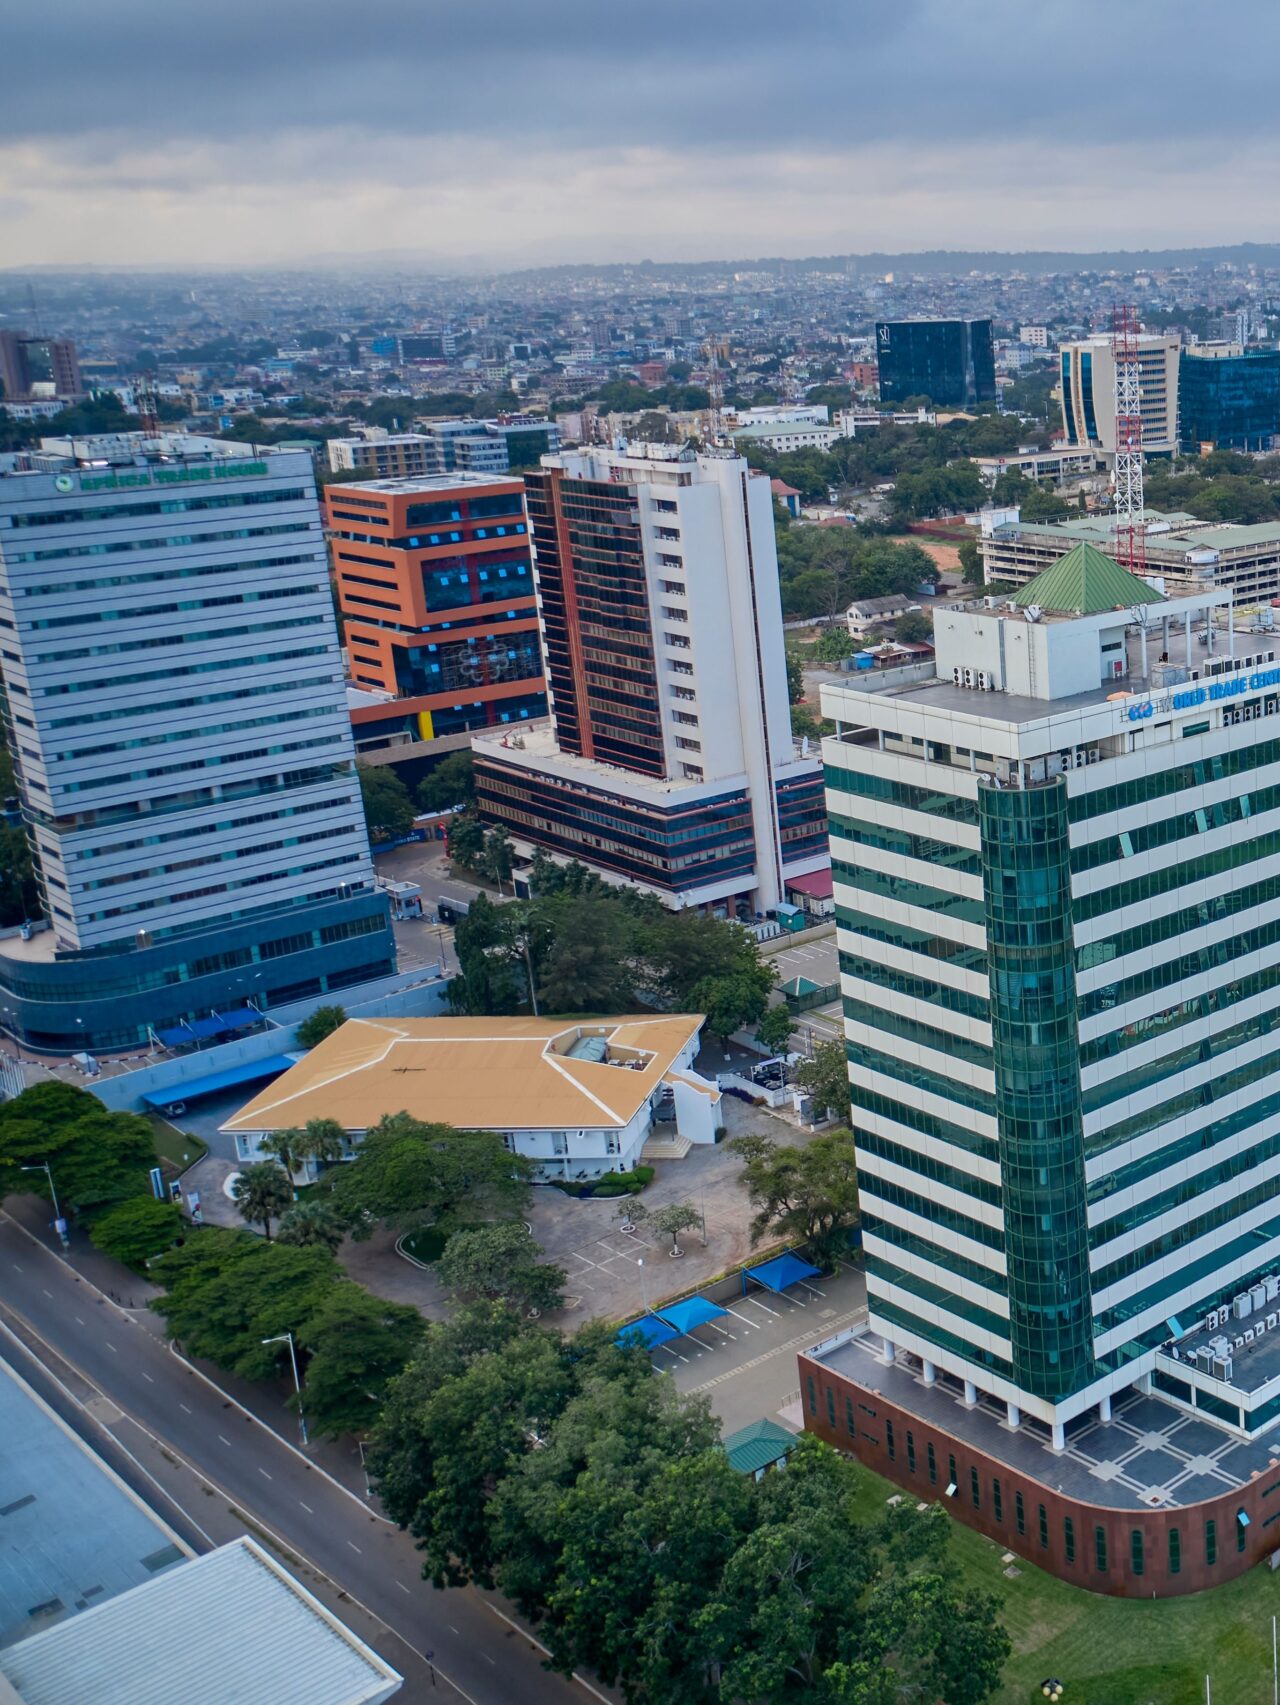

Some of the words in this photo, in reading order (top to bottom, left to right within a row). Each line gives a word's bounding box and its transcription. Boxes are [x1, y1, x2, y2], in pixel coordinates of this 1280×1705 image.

[80, 473, 149, 490] AFRICA
[153, 467, 211, 483] TRADE
[214, 462, 268, 478] HOUSE
[1161, 687, 1206, 713] WORLD
[1209, 678, 1247, 701] TRADE
